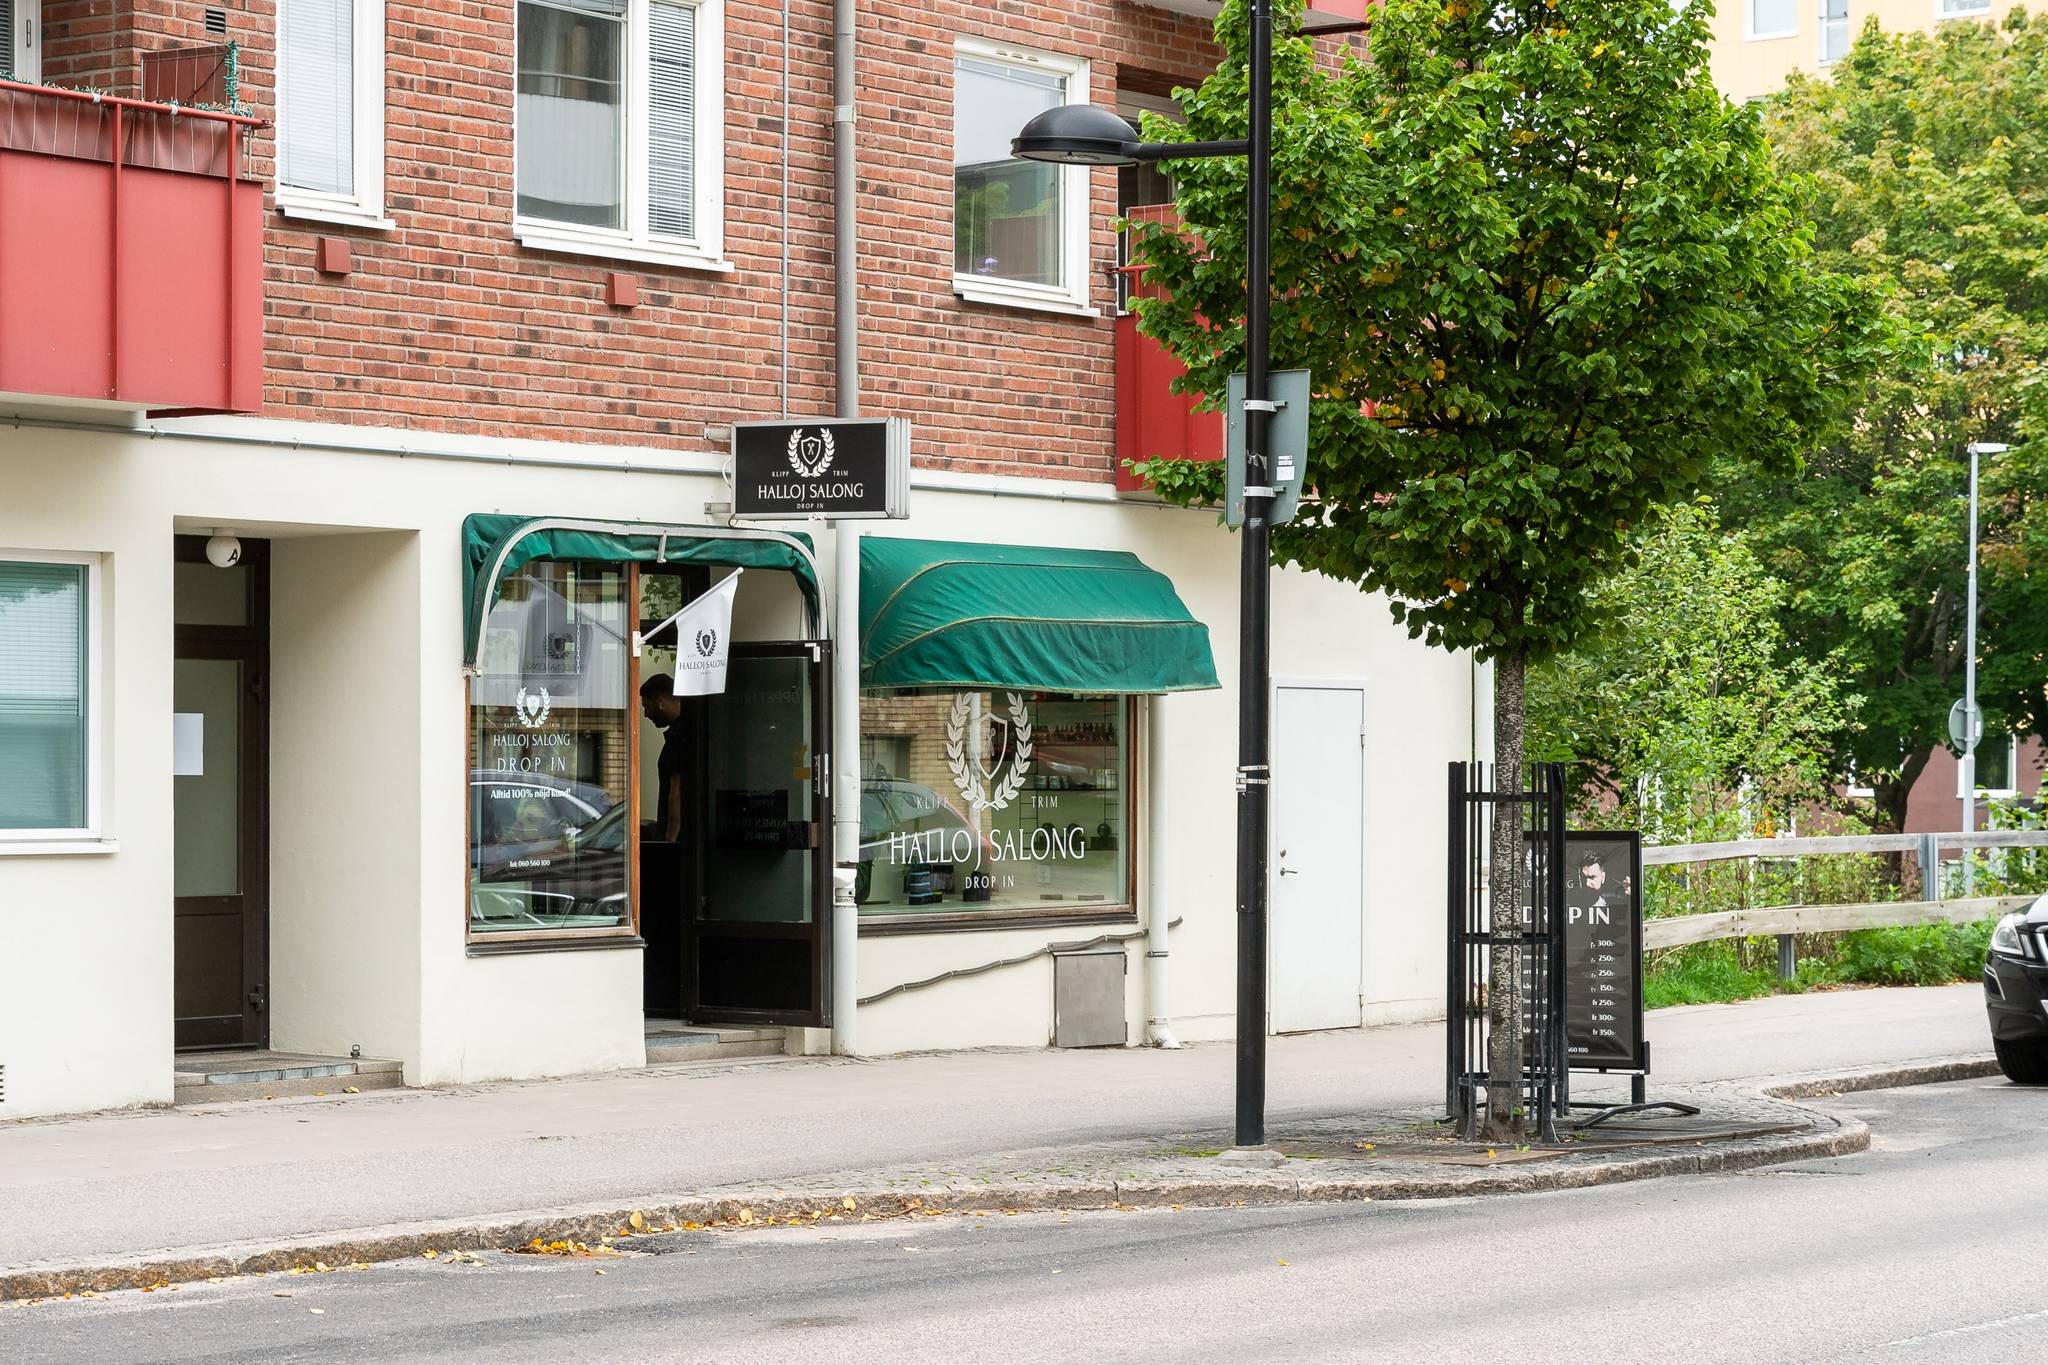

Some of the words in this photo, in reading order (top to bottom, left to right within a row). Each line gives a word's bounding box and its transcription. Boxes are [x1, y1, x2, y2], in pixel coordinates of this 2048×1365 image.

[758, 484, 805, 502] HALLOJ
[809, 482, 864, 499] SALONG
[226, 548, 238, 562] A
[493, 734, 529, 749] HALLOJ
[532, 733, 570, 746] SALONG
[497, 757, 541, 773] DROP
[551, 756, 566, 772] IN
[491, 789, 510, 799] Alltid
[511, 789, 533, 799] 100%
[534, 788, 550, 799] nöjd
[916, 797, 949, 809] KLIPP
[1032, 796, 1058, 808] TRIM
[890, 830, 982, 871] HALLOJ
[989, 827, 1086, 862] SALONG
[965, 876, 997, 889] DROP
[1003, 875, 1014, 888] IN
[1588, 907, 1610, 925] IN
